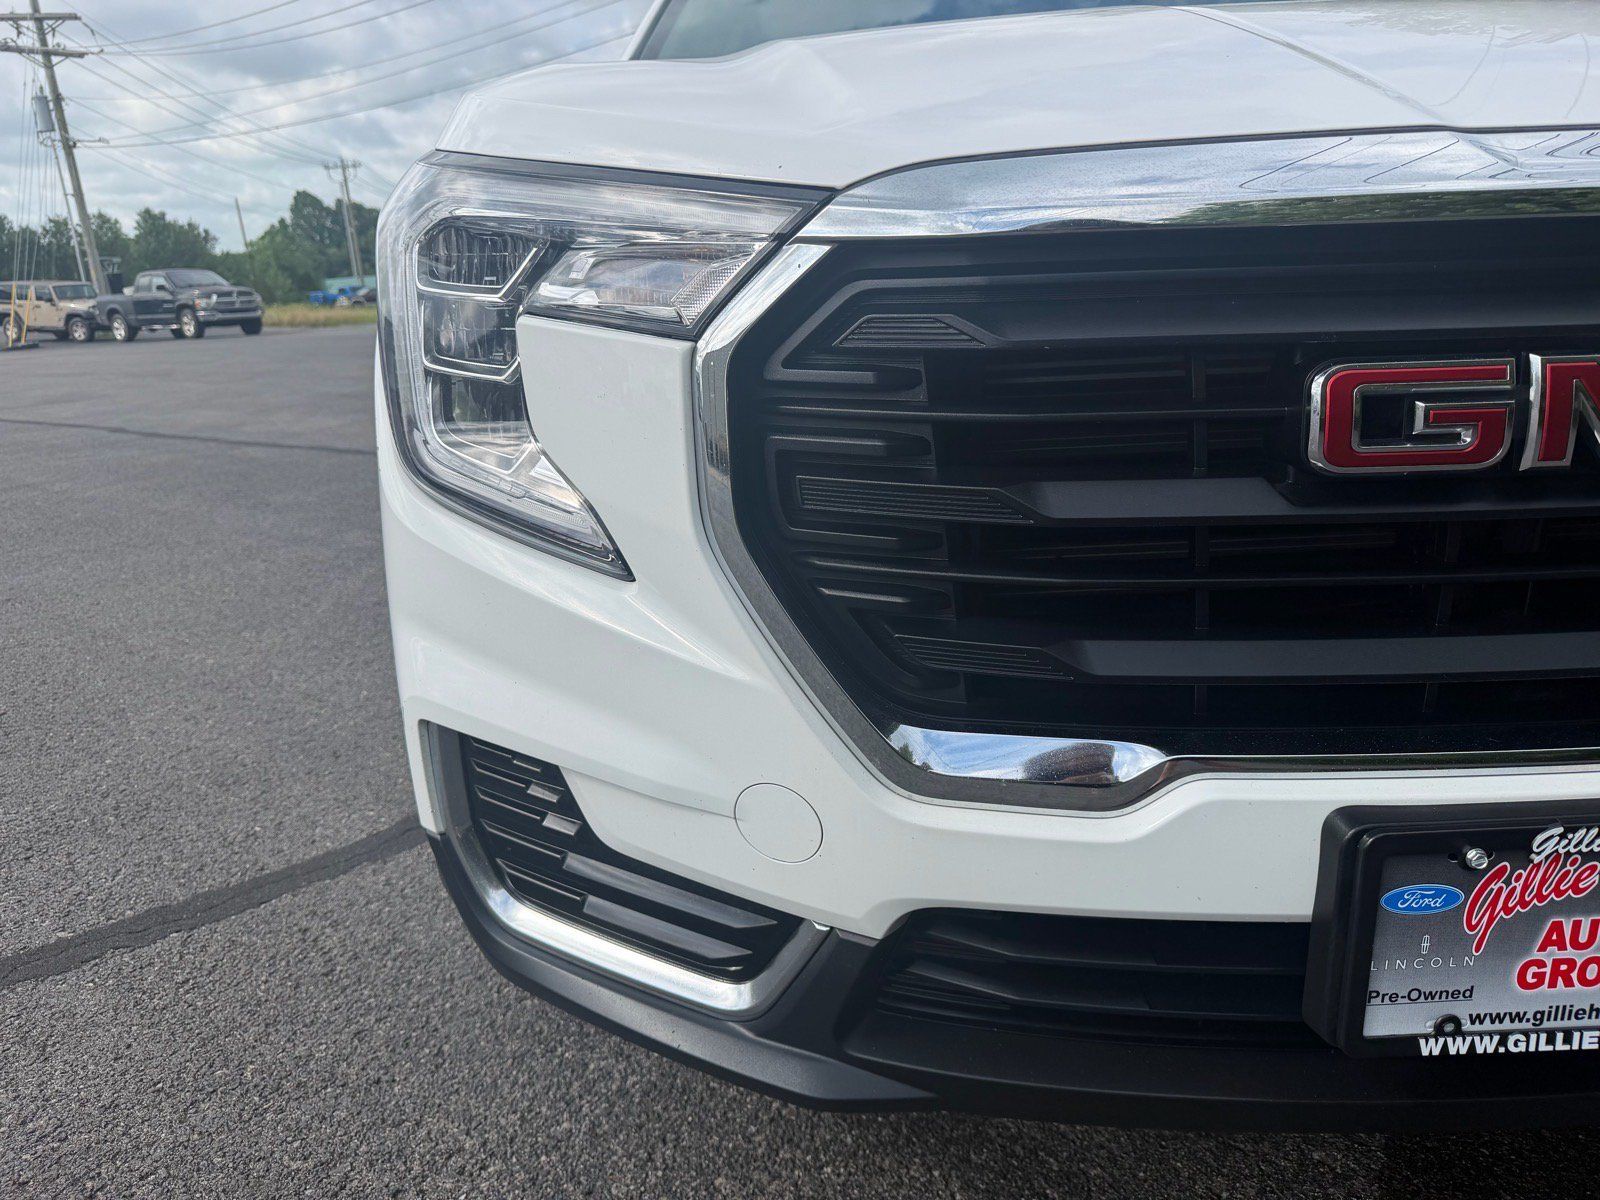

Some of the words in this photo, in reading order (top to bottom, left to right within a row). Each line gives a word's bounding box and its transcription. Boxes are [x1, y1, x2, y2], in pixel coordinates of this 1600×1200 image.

[1398, 890, 1446, 908] Ford
[1464, 853, 1600, 955] Gillie
[1371, 956, 1475, 971] LINCOLN
[1367, 985, 1475, 1004] Pre-Owned
[1469, 1003, 1600, 1027] www.gillieh
[1419, 1031, 1600, 1056] WWW.GILLIE
